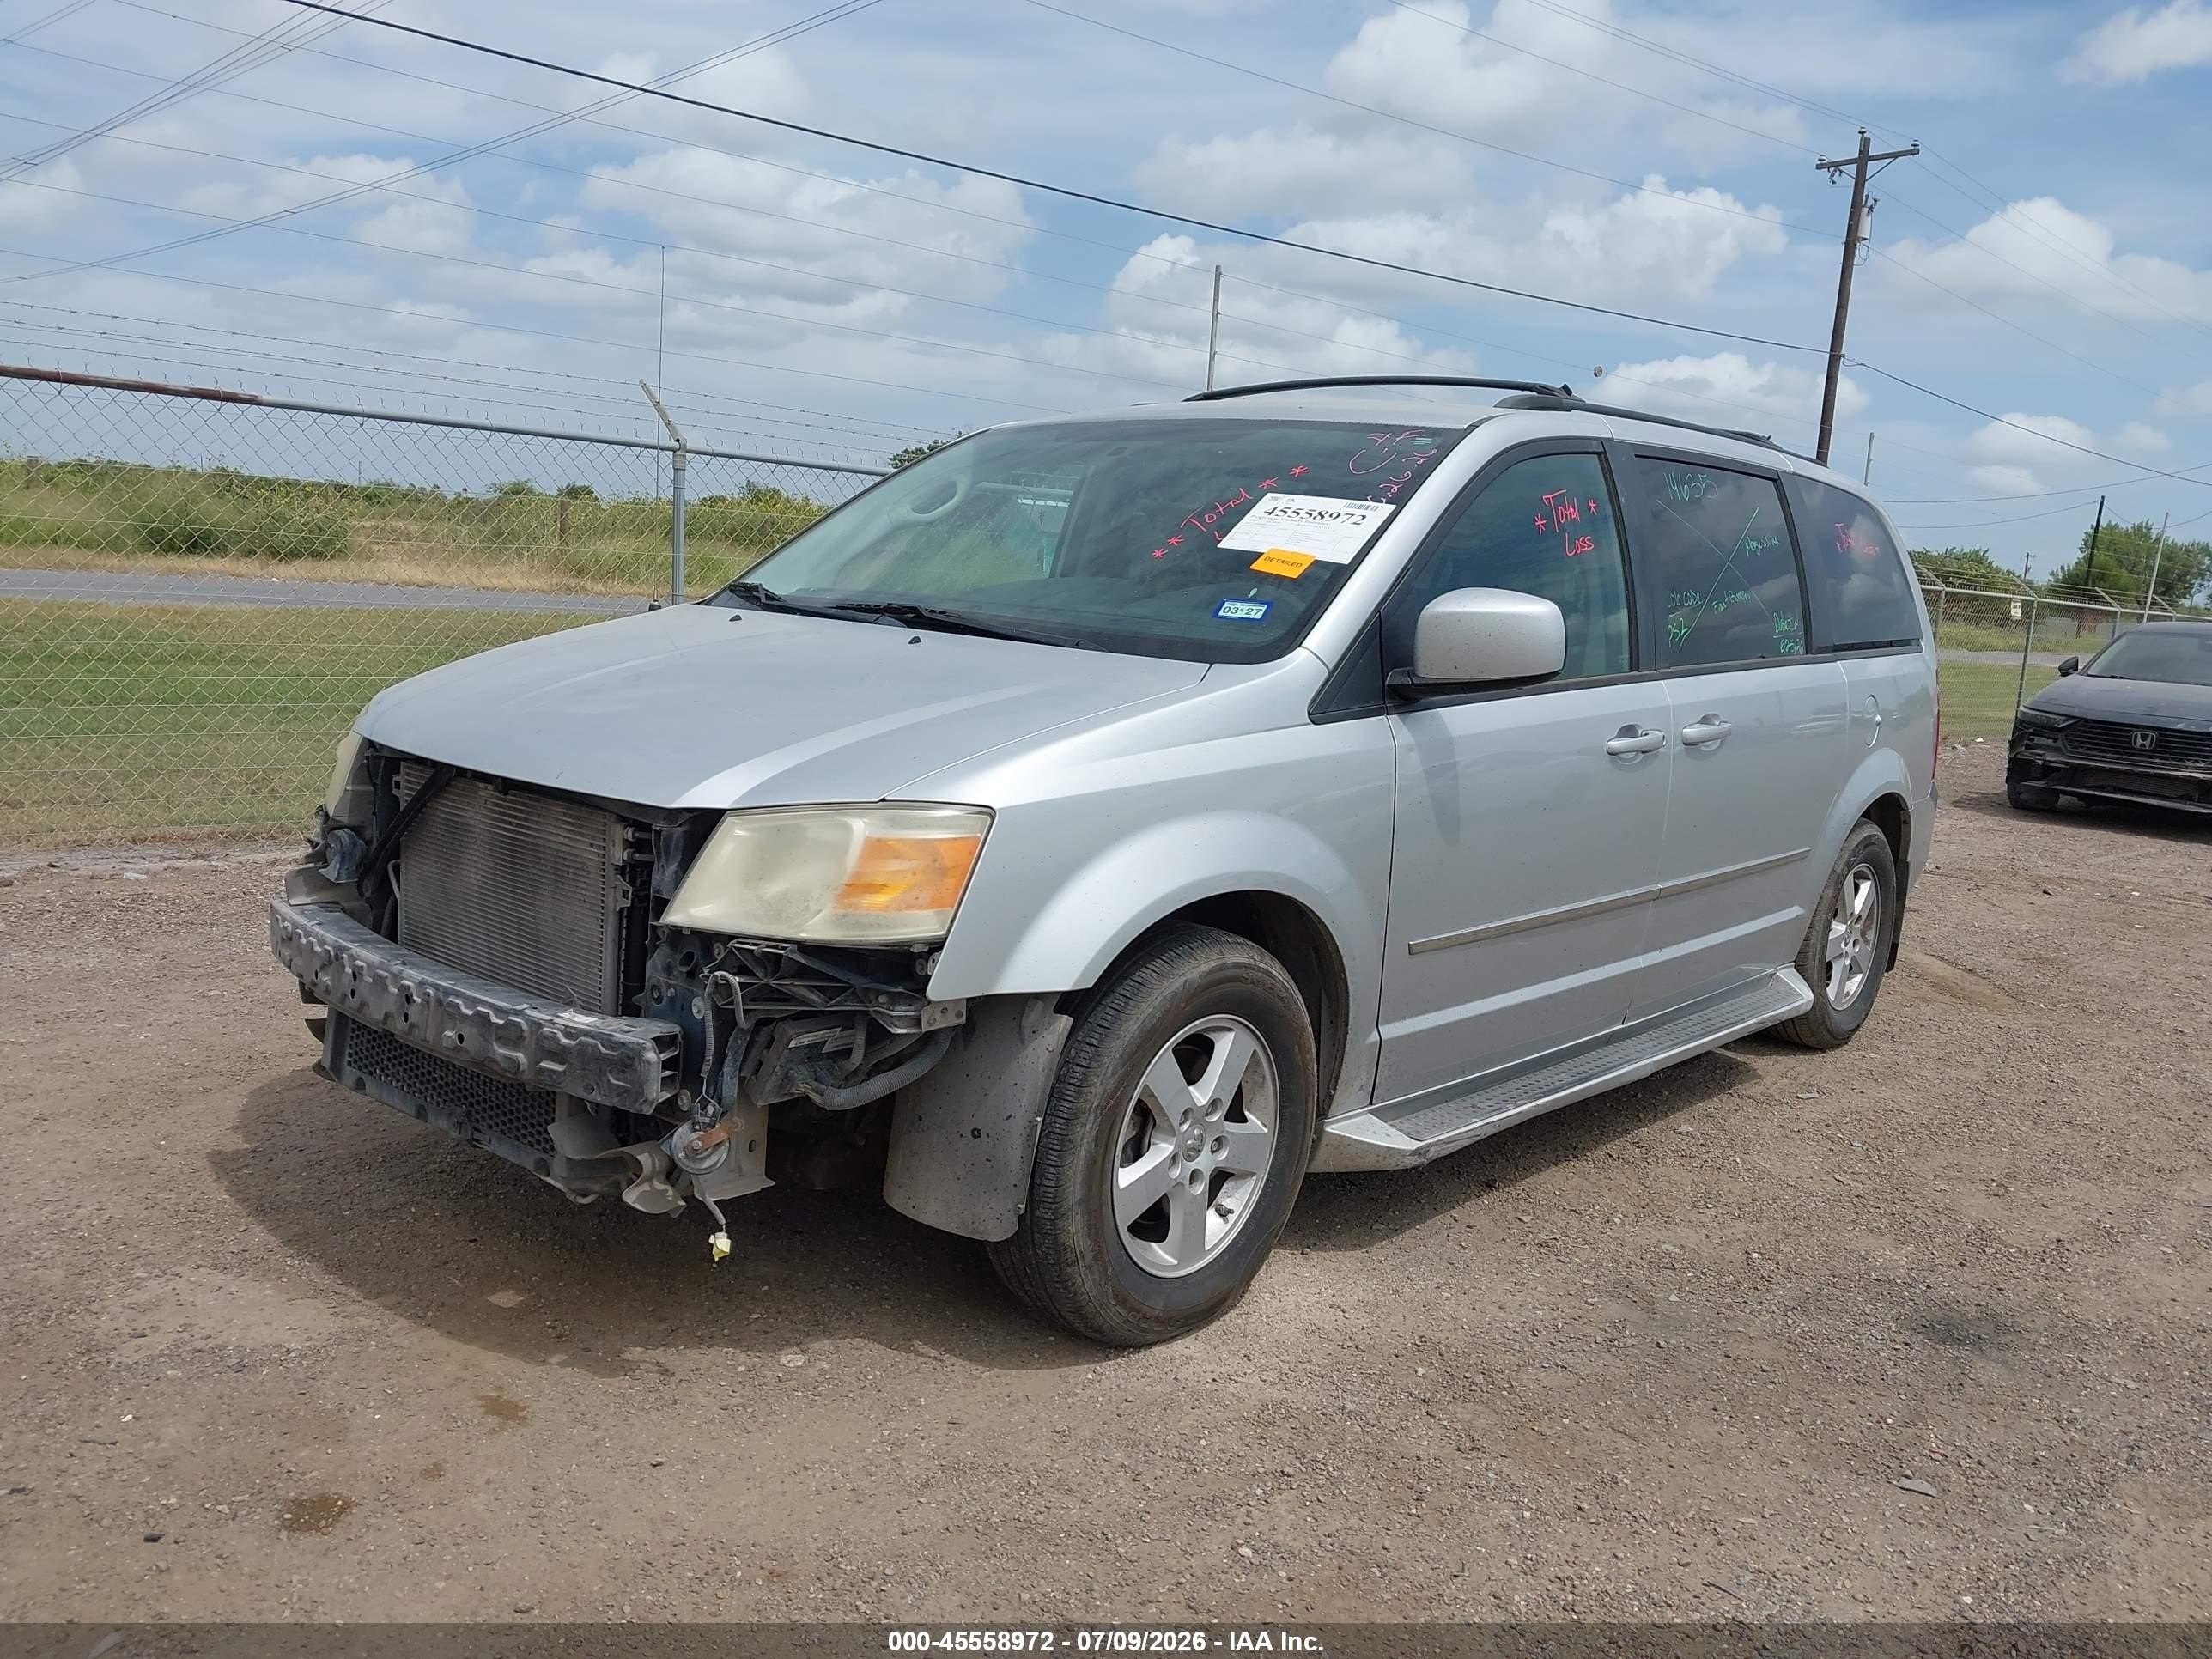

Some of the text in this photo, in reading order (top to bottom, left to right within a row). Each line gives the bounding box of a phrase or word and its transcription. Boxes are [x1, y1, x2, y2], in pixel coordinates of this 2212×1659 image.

[1663, 471, 1718, 501] 14635
[1180, 488, 1254, 532] Total
[1263, 506, 1367, 526] 45558972
[1542, 489, 1581, 533] Total
[1565, 532, 1595, 556] Loss
[1263, 556, 1304, 568] DETAILED
